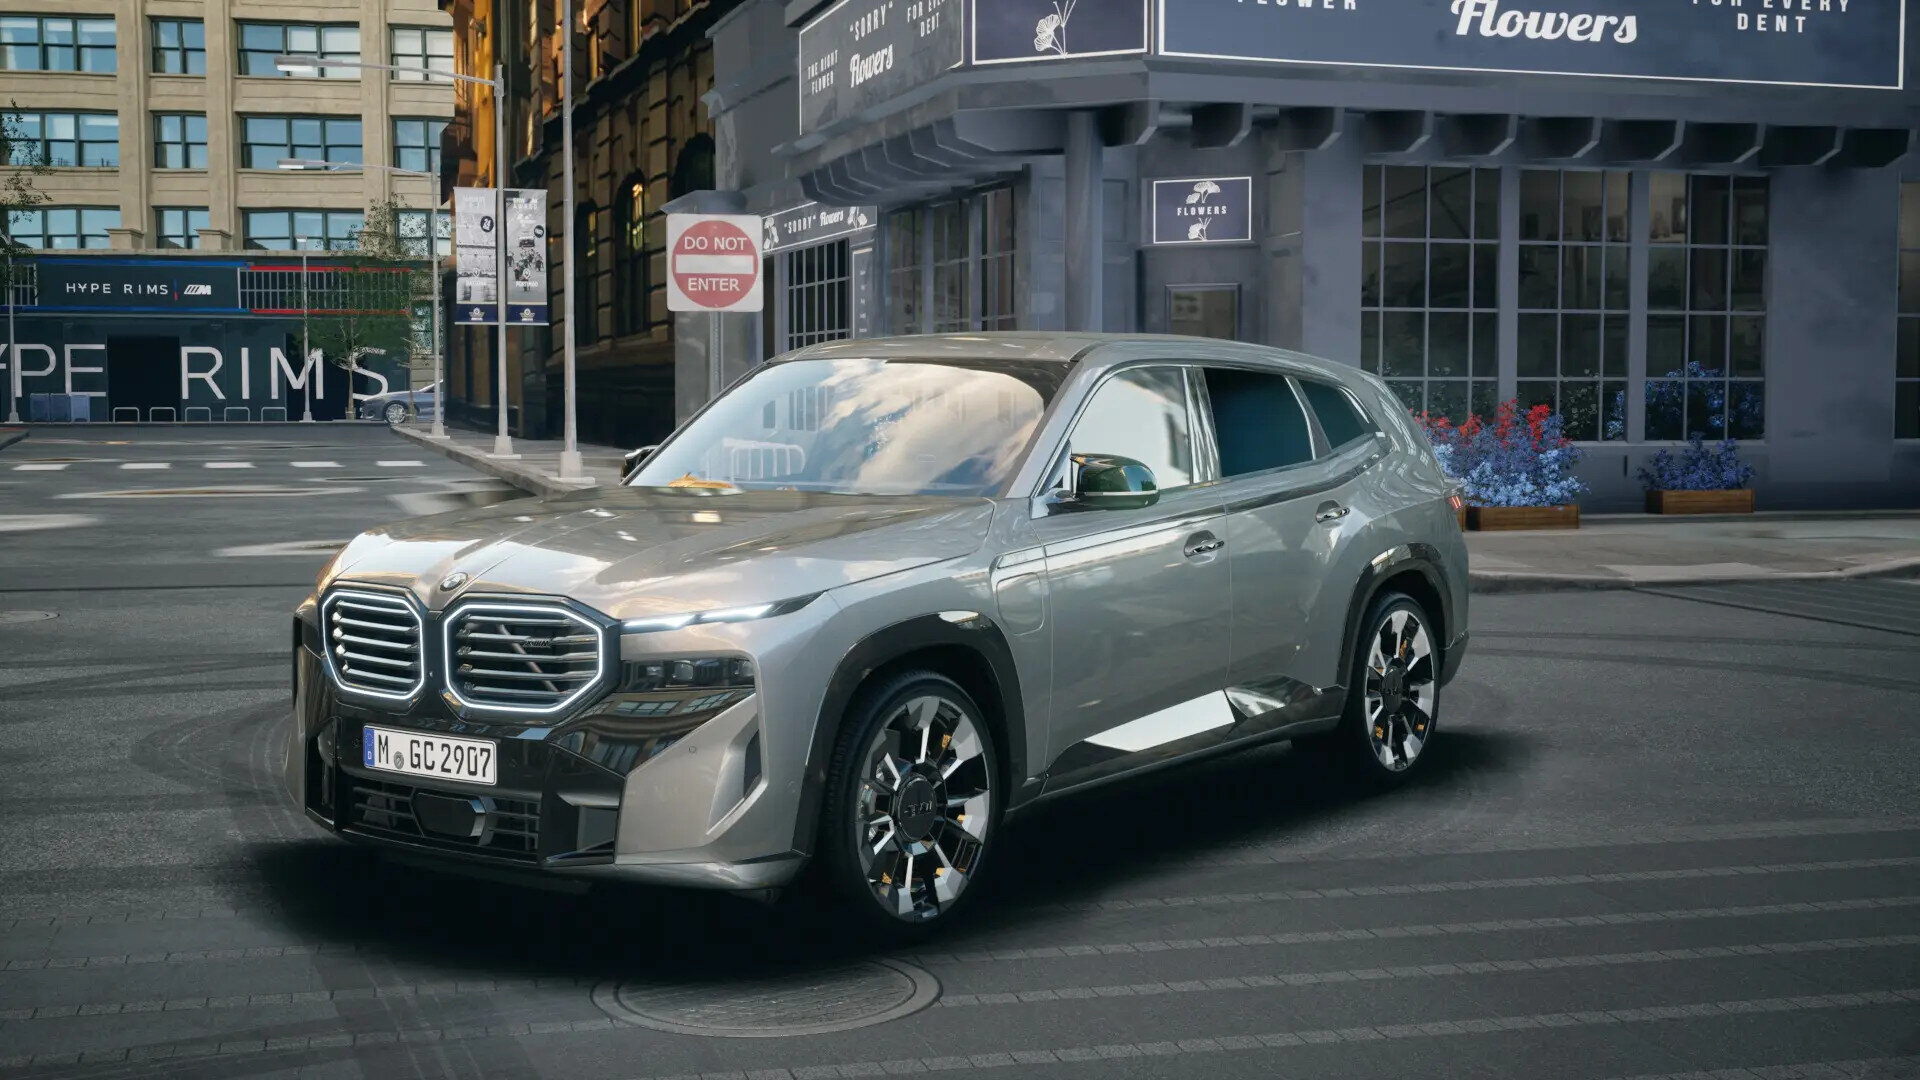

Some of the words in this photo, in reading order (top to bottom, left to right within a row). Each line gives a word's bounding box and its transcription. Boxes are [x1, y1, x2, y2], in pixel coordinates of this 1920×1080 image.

[920, 12, 939, 37] DENT
[1450, 0, 1638, 43] Flowers
[1737, 13, 1806, 33] DENT
[807, 62, 818, 80] THE
[850, 44, 893, 88] Flowers
[811, 70, 834, 95] FLOWER
[1177, 205, 1227, 216] FLOWERS
[684, 236, 708, 250] DO
[714, 237, 747, 251] NOT
[66, 283, 111, 294] HYPE
[124, 284, 168, 295] RIMS
[688, 277, 740, 291] ENTER
[0, 343, 107, 398] PE
[181, 346, 389, 401] RIMS
[378, 734, 389, 764] M
